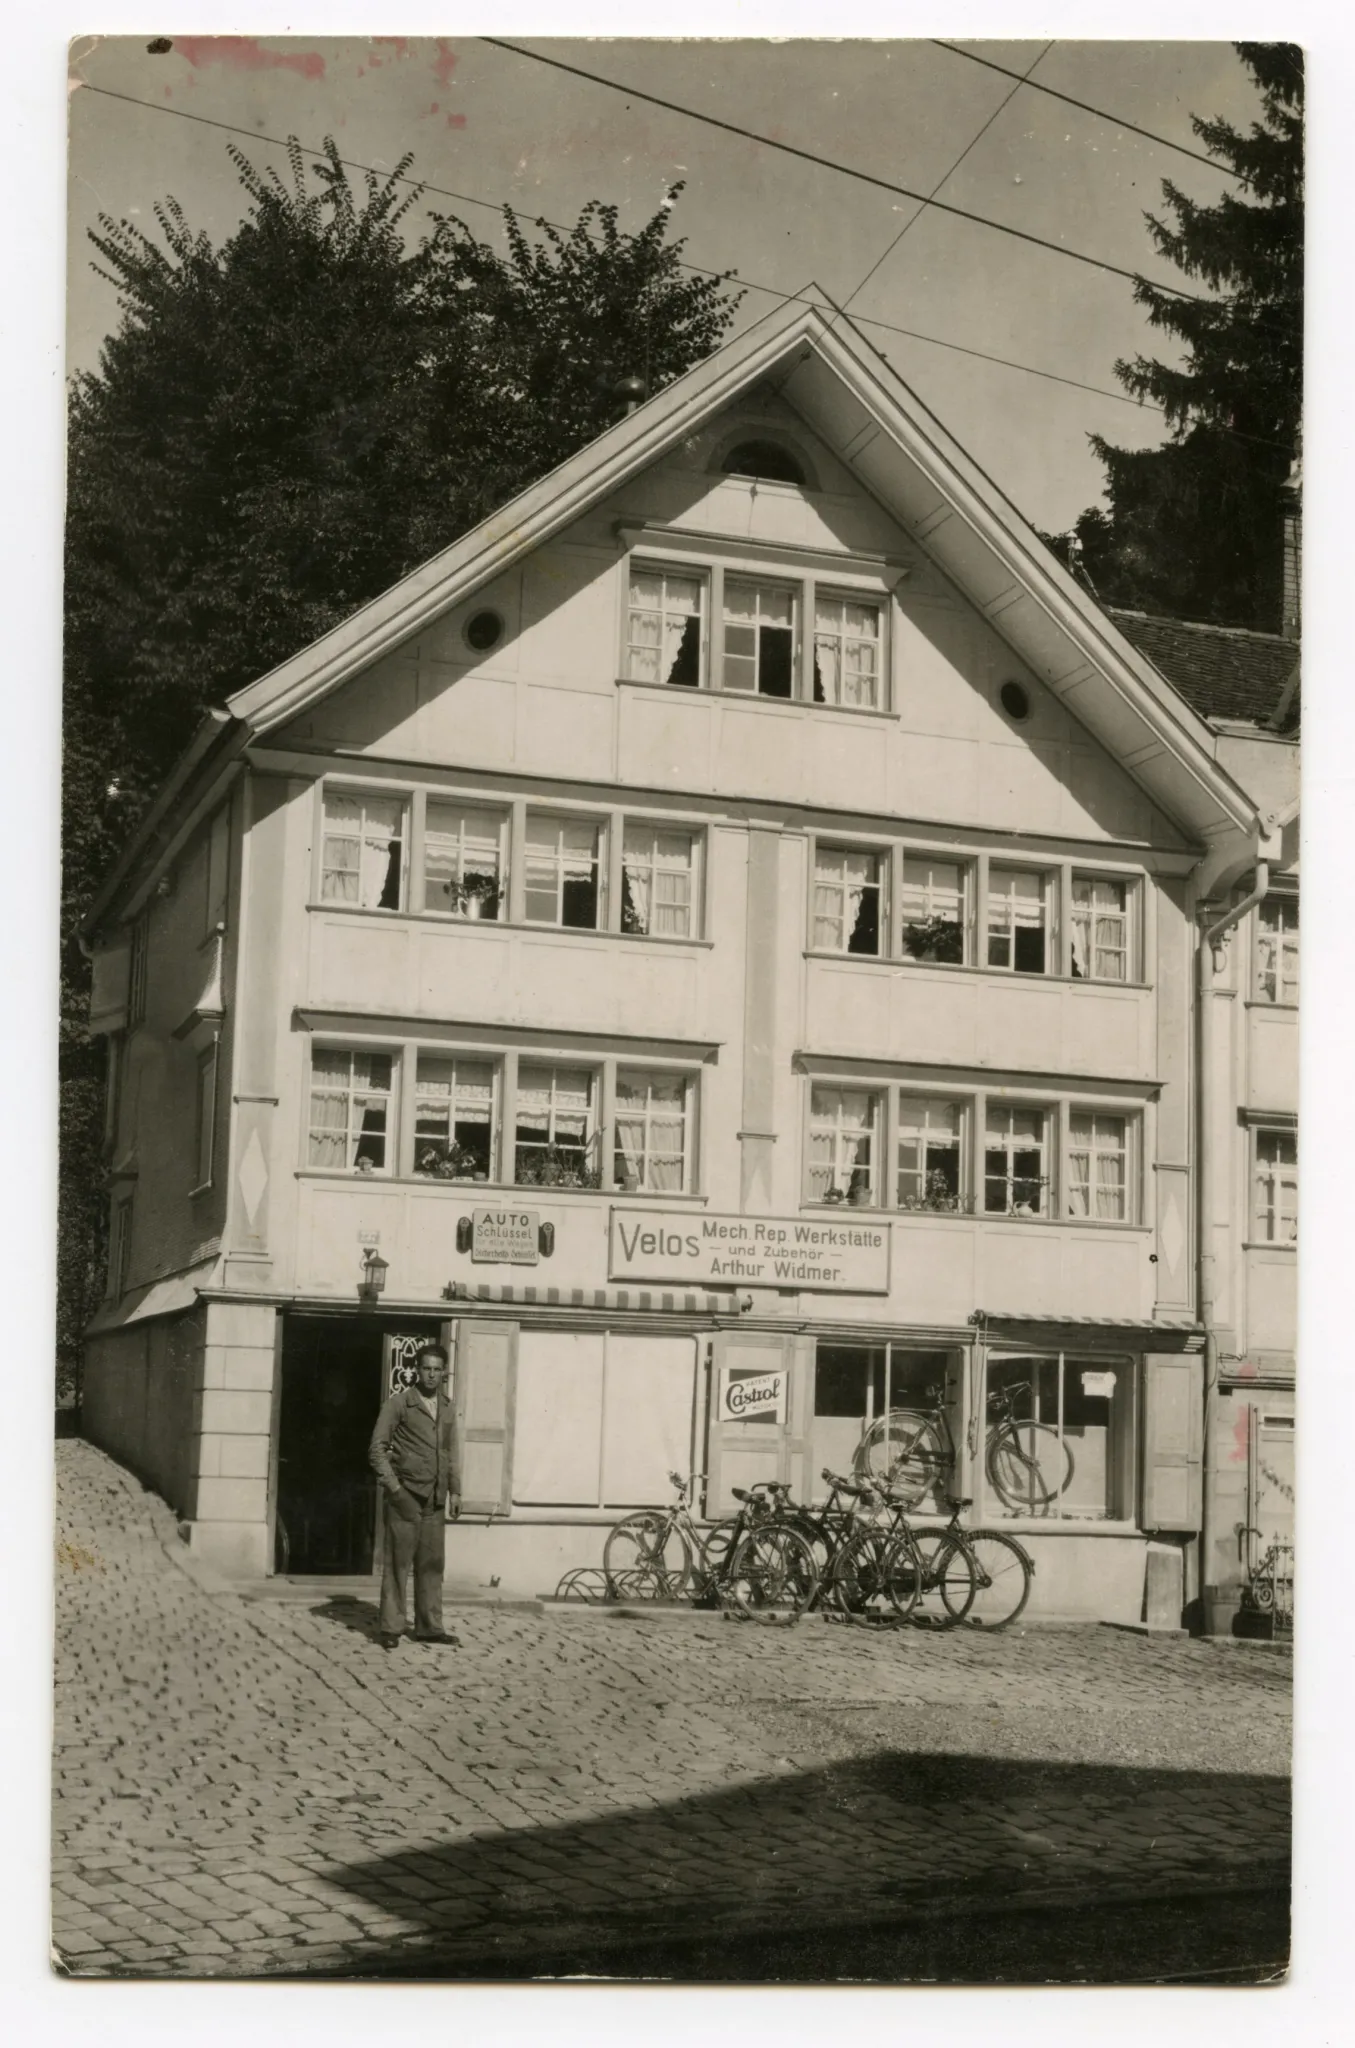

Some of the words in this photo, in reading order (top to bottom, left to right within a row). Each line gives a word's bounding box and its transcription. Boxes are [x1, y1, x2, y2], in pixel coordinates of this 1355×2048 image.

[482, 1213, 529, 1226] AUTO
[477, 1225, 532, 1239] Schlüssel
[618, 1222, 700, 1262] Velos
[794, 1226, 882, 1248] Werkstätte
[728, 1245, 756, 1256] und
[763, 1246, 824, 1260] Zubehör
[710, 1257, 765, 1277] Arthur
[726, 1378, 780, 1414] Castrol
